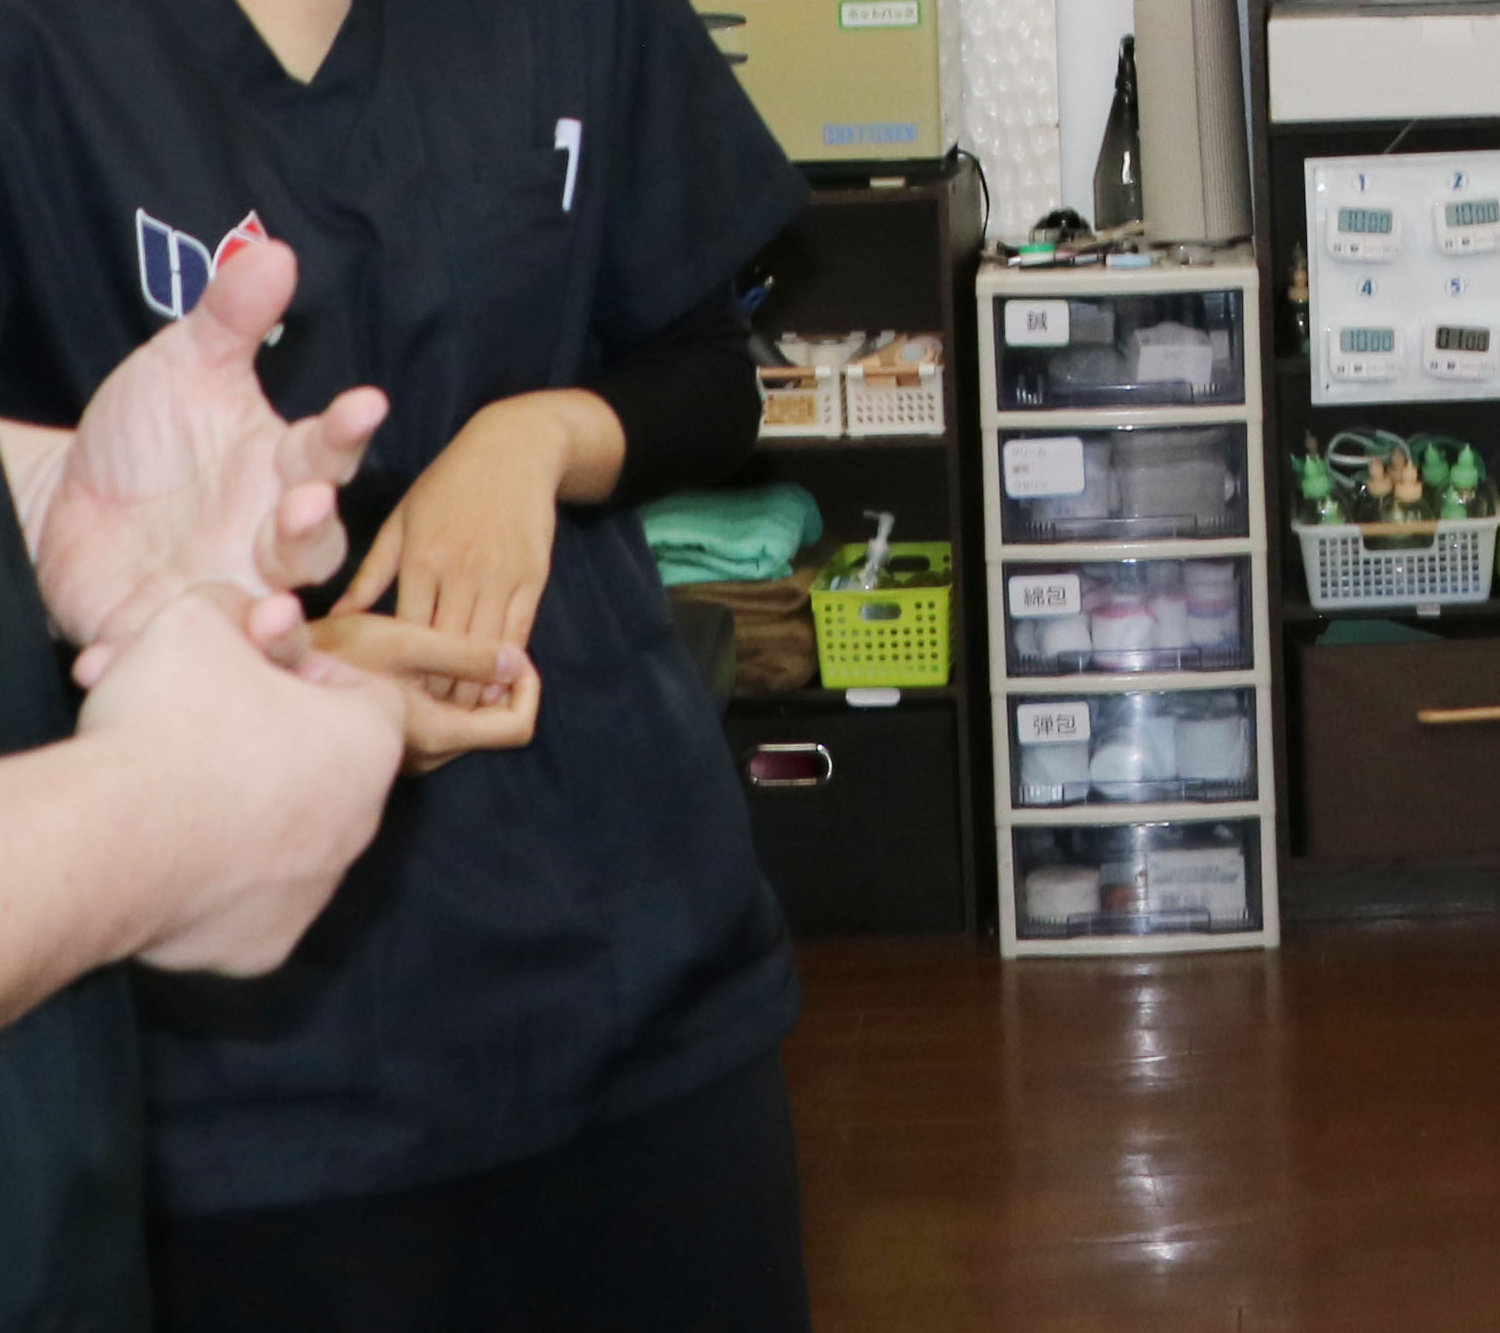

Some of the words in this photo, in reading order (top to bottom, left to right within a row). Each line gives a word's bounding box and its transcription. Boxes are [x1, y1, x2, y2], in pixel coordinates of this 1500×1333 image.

[1453, 172, 1463, 190] 2
[1361, 279, 1372, 295] 4
[1450, 278, 1460, 294] 5
[1032, 714, 1077, 737] 弾包
